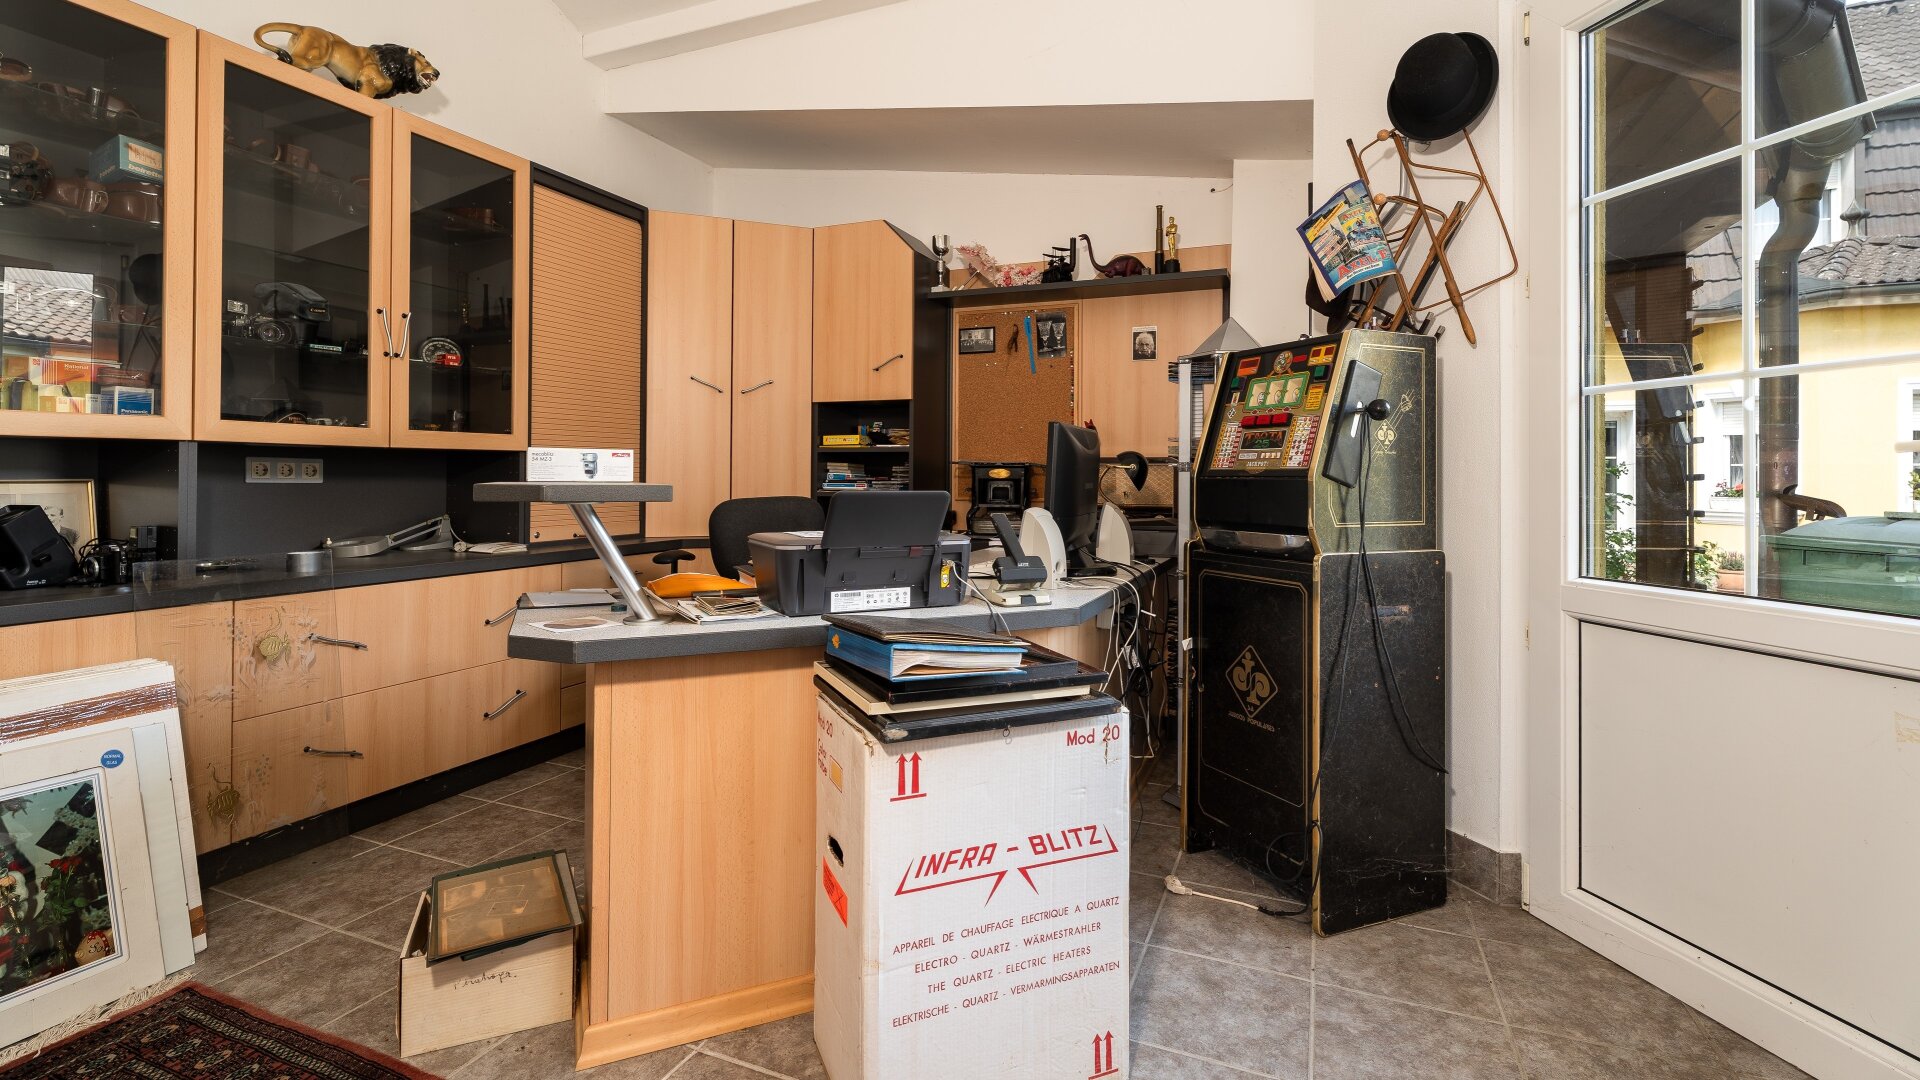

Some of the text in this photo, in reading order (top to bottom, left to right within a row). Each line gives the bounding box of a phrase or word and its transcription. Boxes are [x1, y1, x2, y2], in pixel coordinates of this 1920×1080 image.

[1066, 724, 1121, 747] Mod 20
[914, 842, 998, 879] INFRA
[1027, 824, 1103, 856] BLITZ
[893, 896, 1120, 955] APPAREIL DE CHAUFFAGE ELECTRIQUE A QUARTZ
[914, 955, 958, 974] ELECTRO
[970, 942, 1011, 960] QUARTZ
[1023, 921, 1101, 947] WÄRMESTRAHLER
[892, 1004, 950, 1028] ELEKTRISCHE
[962, 991, 999, 1009] QUARTZ
[1010, 960, 1120, 996] VERMARMINGSAPPARATEN
[927, 980, 946, 994] THE
[953, 969, 994, 988] QUARTZ
[1005, 956, 1047, 974] ELECTRIC
[1053, 945, 1091, 963] HEATERS
